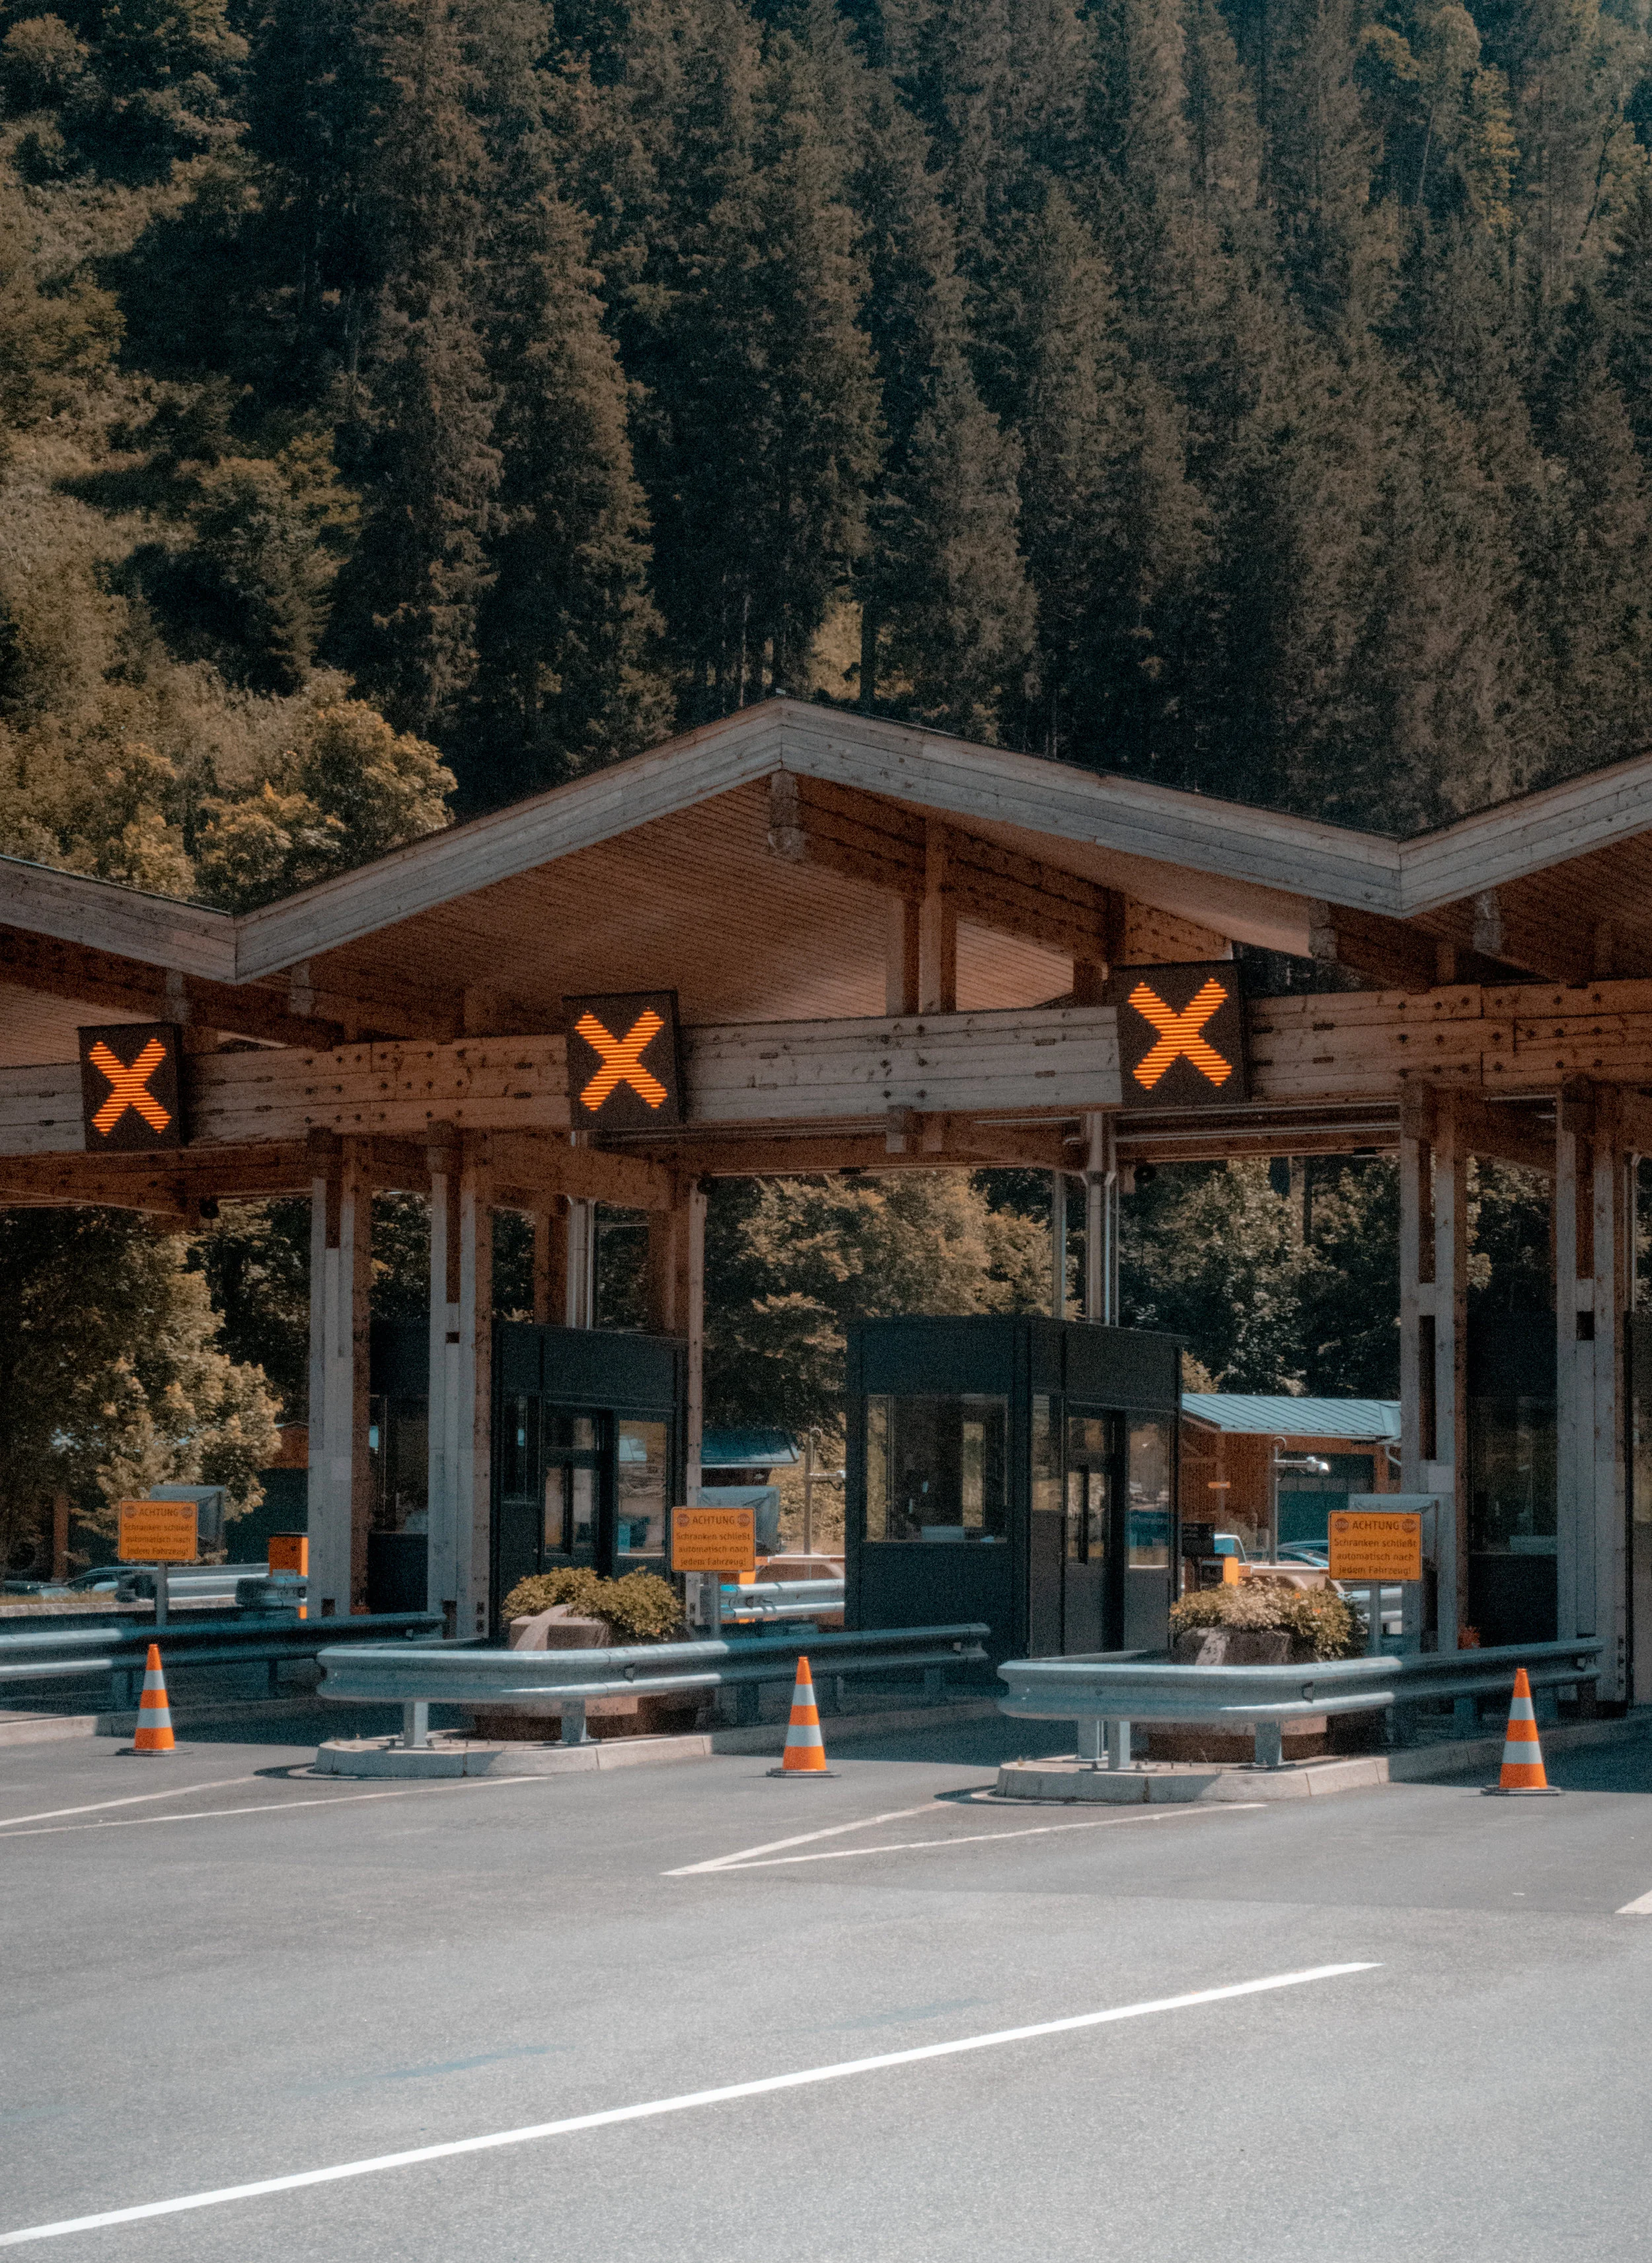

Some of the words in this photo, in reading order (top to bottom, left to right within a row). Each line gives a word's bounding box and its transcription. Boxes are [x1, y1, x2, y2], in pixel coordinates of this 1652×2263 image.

[139, 1508, 179, 1517] ACHTUNG
[692, 1516, 735, 1524] ACHTUNG
[1352, 1520, 1400, 1530] ACHTUNG
[1334, 1538, 1379, 1547] Schranken
[1381, 1539, 1416, 1547] schließt
[680, 1558, 705, 1567] jedem
[1338, 1565, 1365, 1575] jedem
[1369, 1566, 1411, 1576] Fahrzeug!
